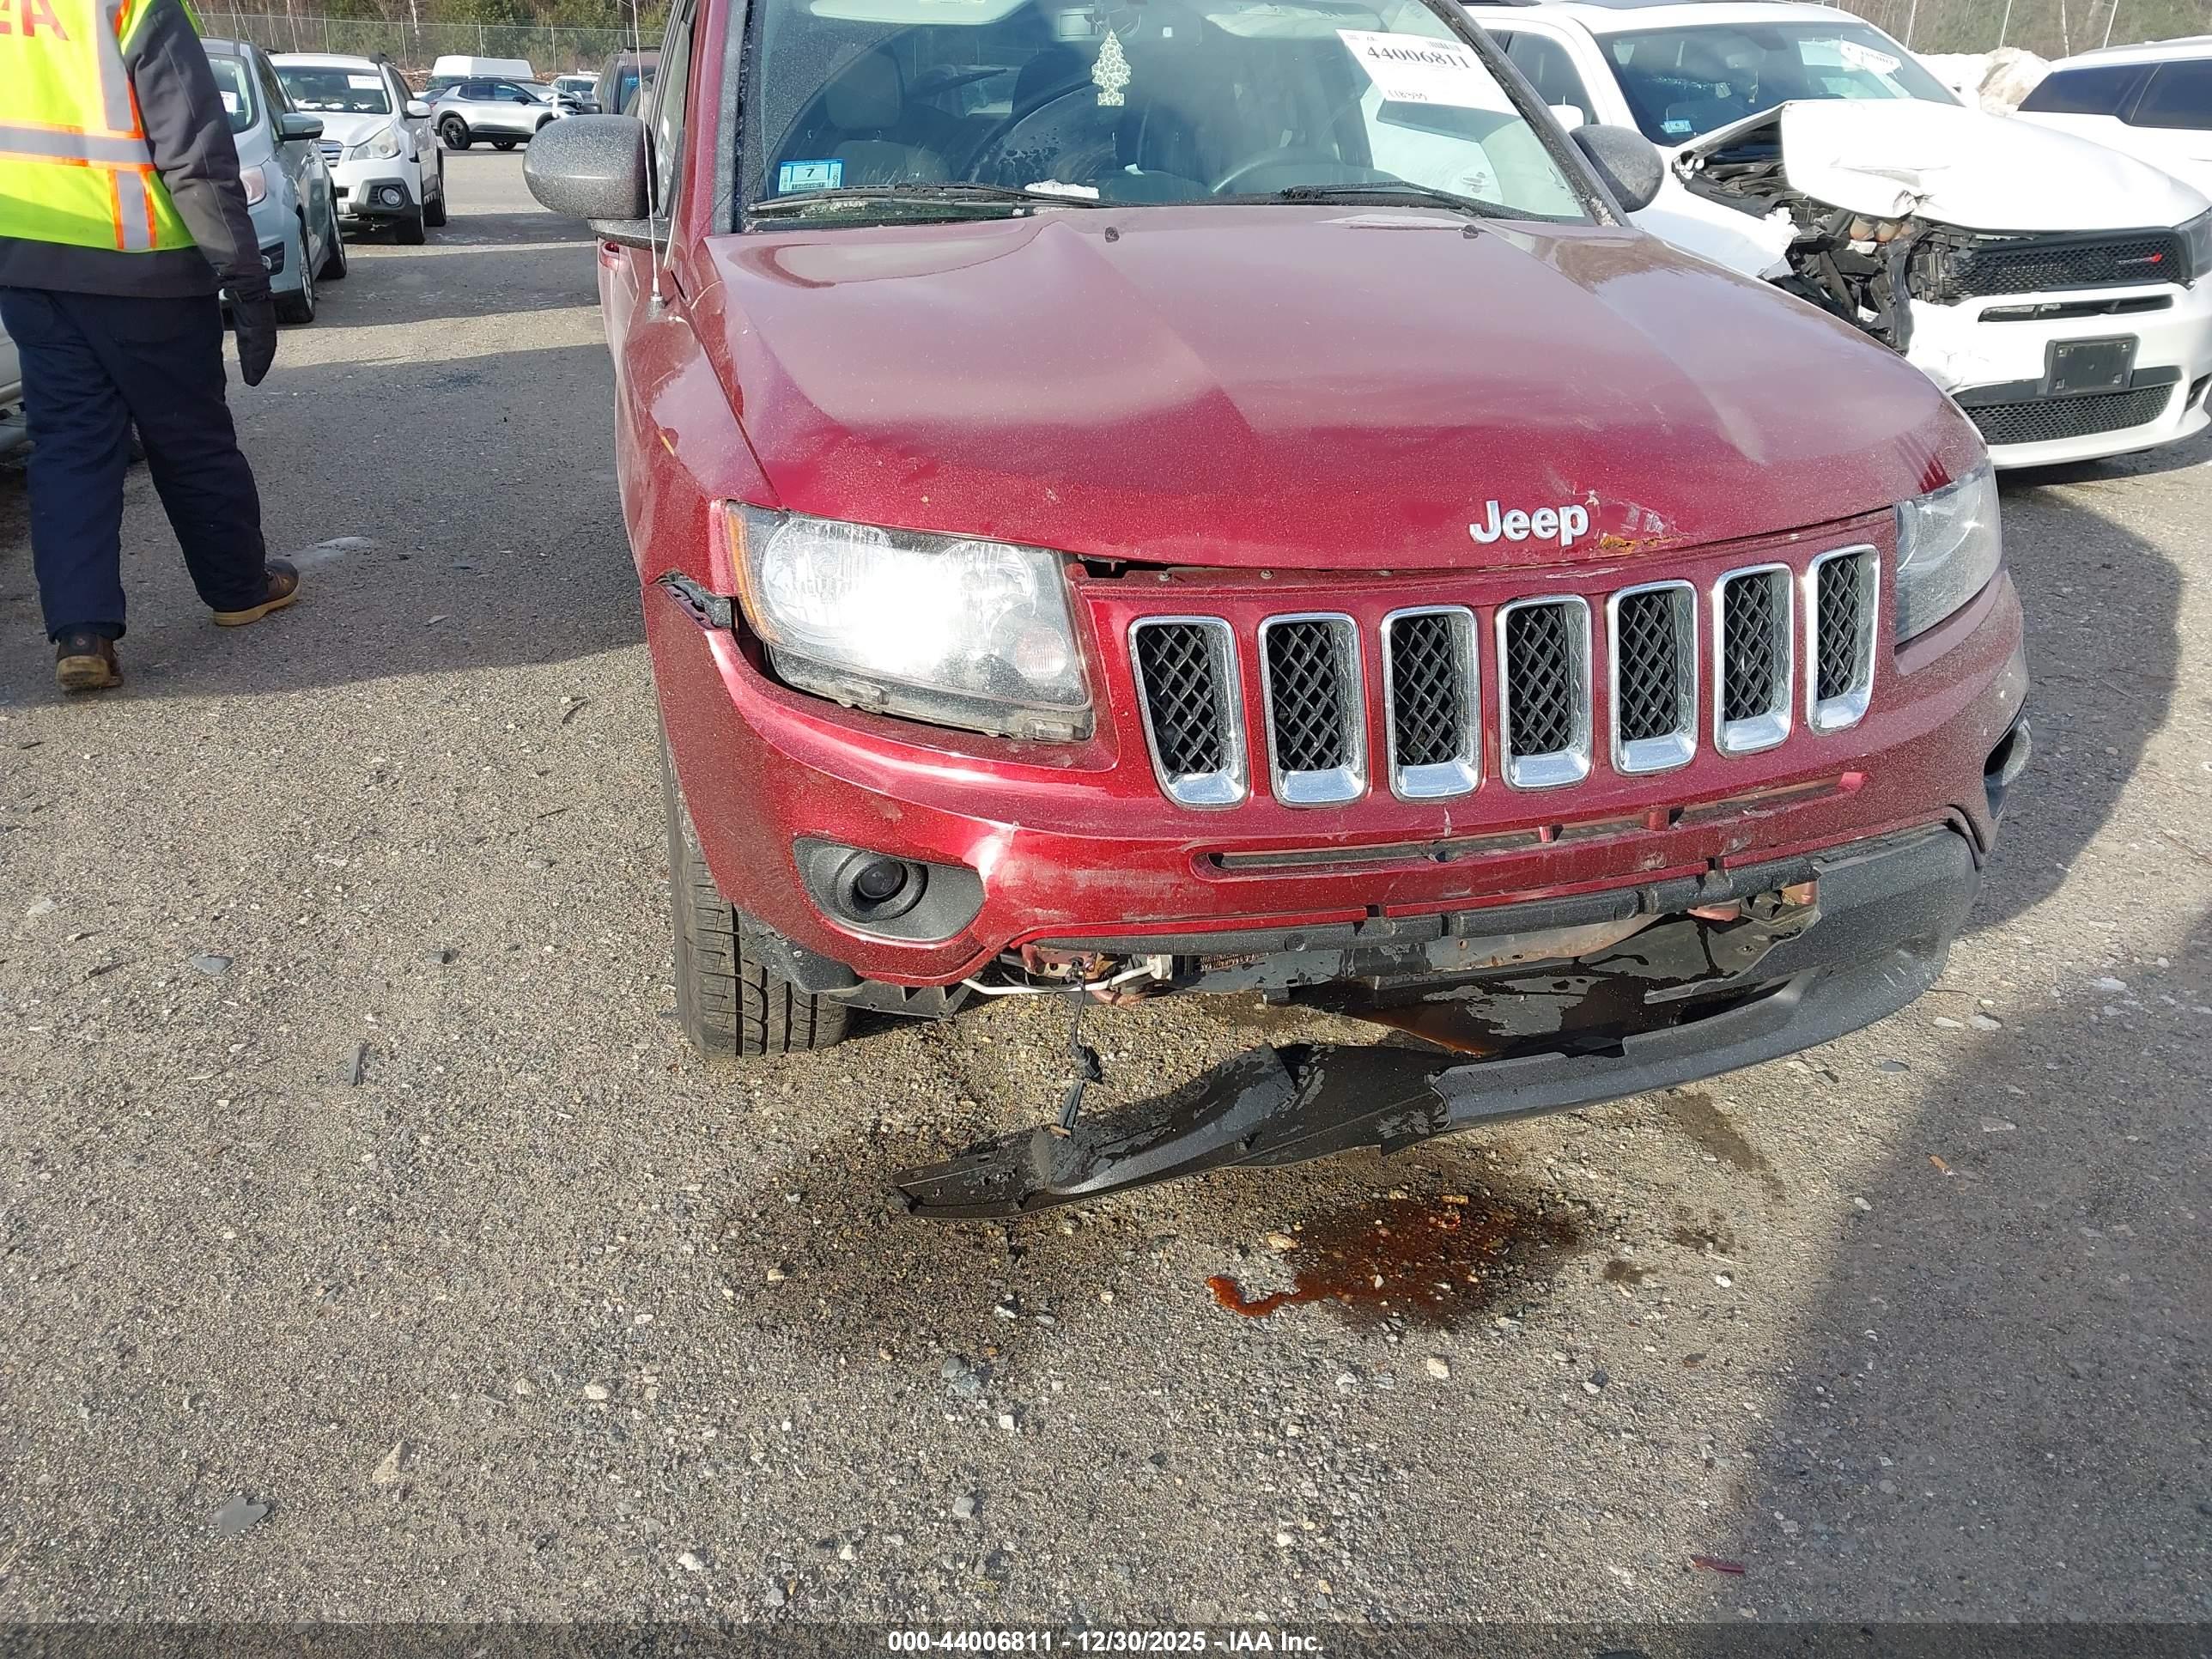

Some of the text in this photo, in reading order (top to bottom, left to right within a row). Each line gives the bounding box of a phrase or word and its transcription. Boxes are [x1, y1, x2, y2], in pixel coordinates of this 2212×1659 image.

[1367, 46, 1471, 69] 44006811
[805, 167, 816, 178] 7
[1469, 500, 1589, 547] Jeep
